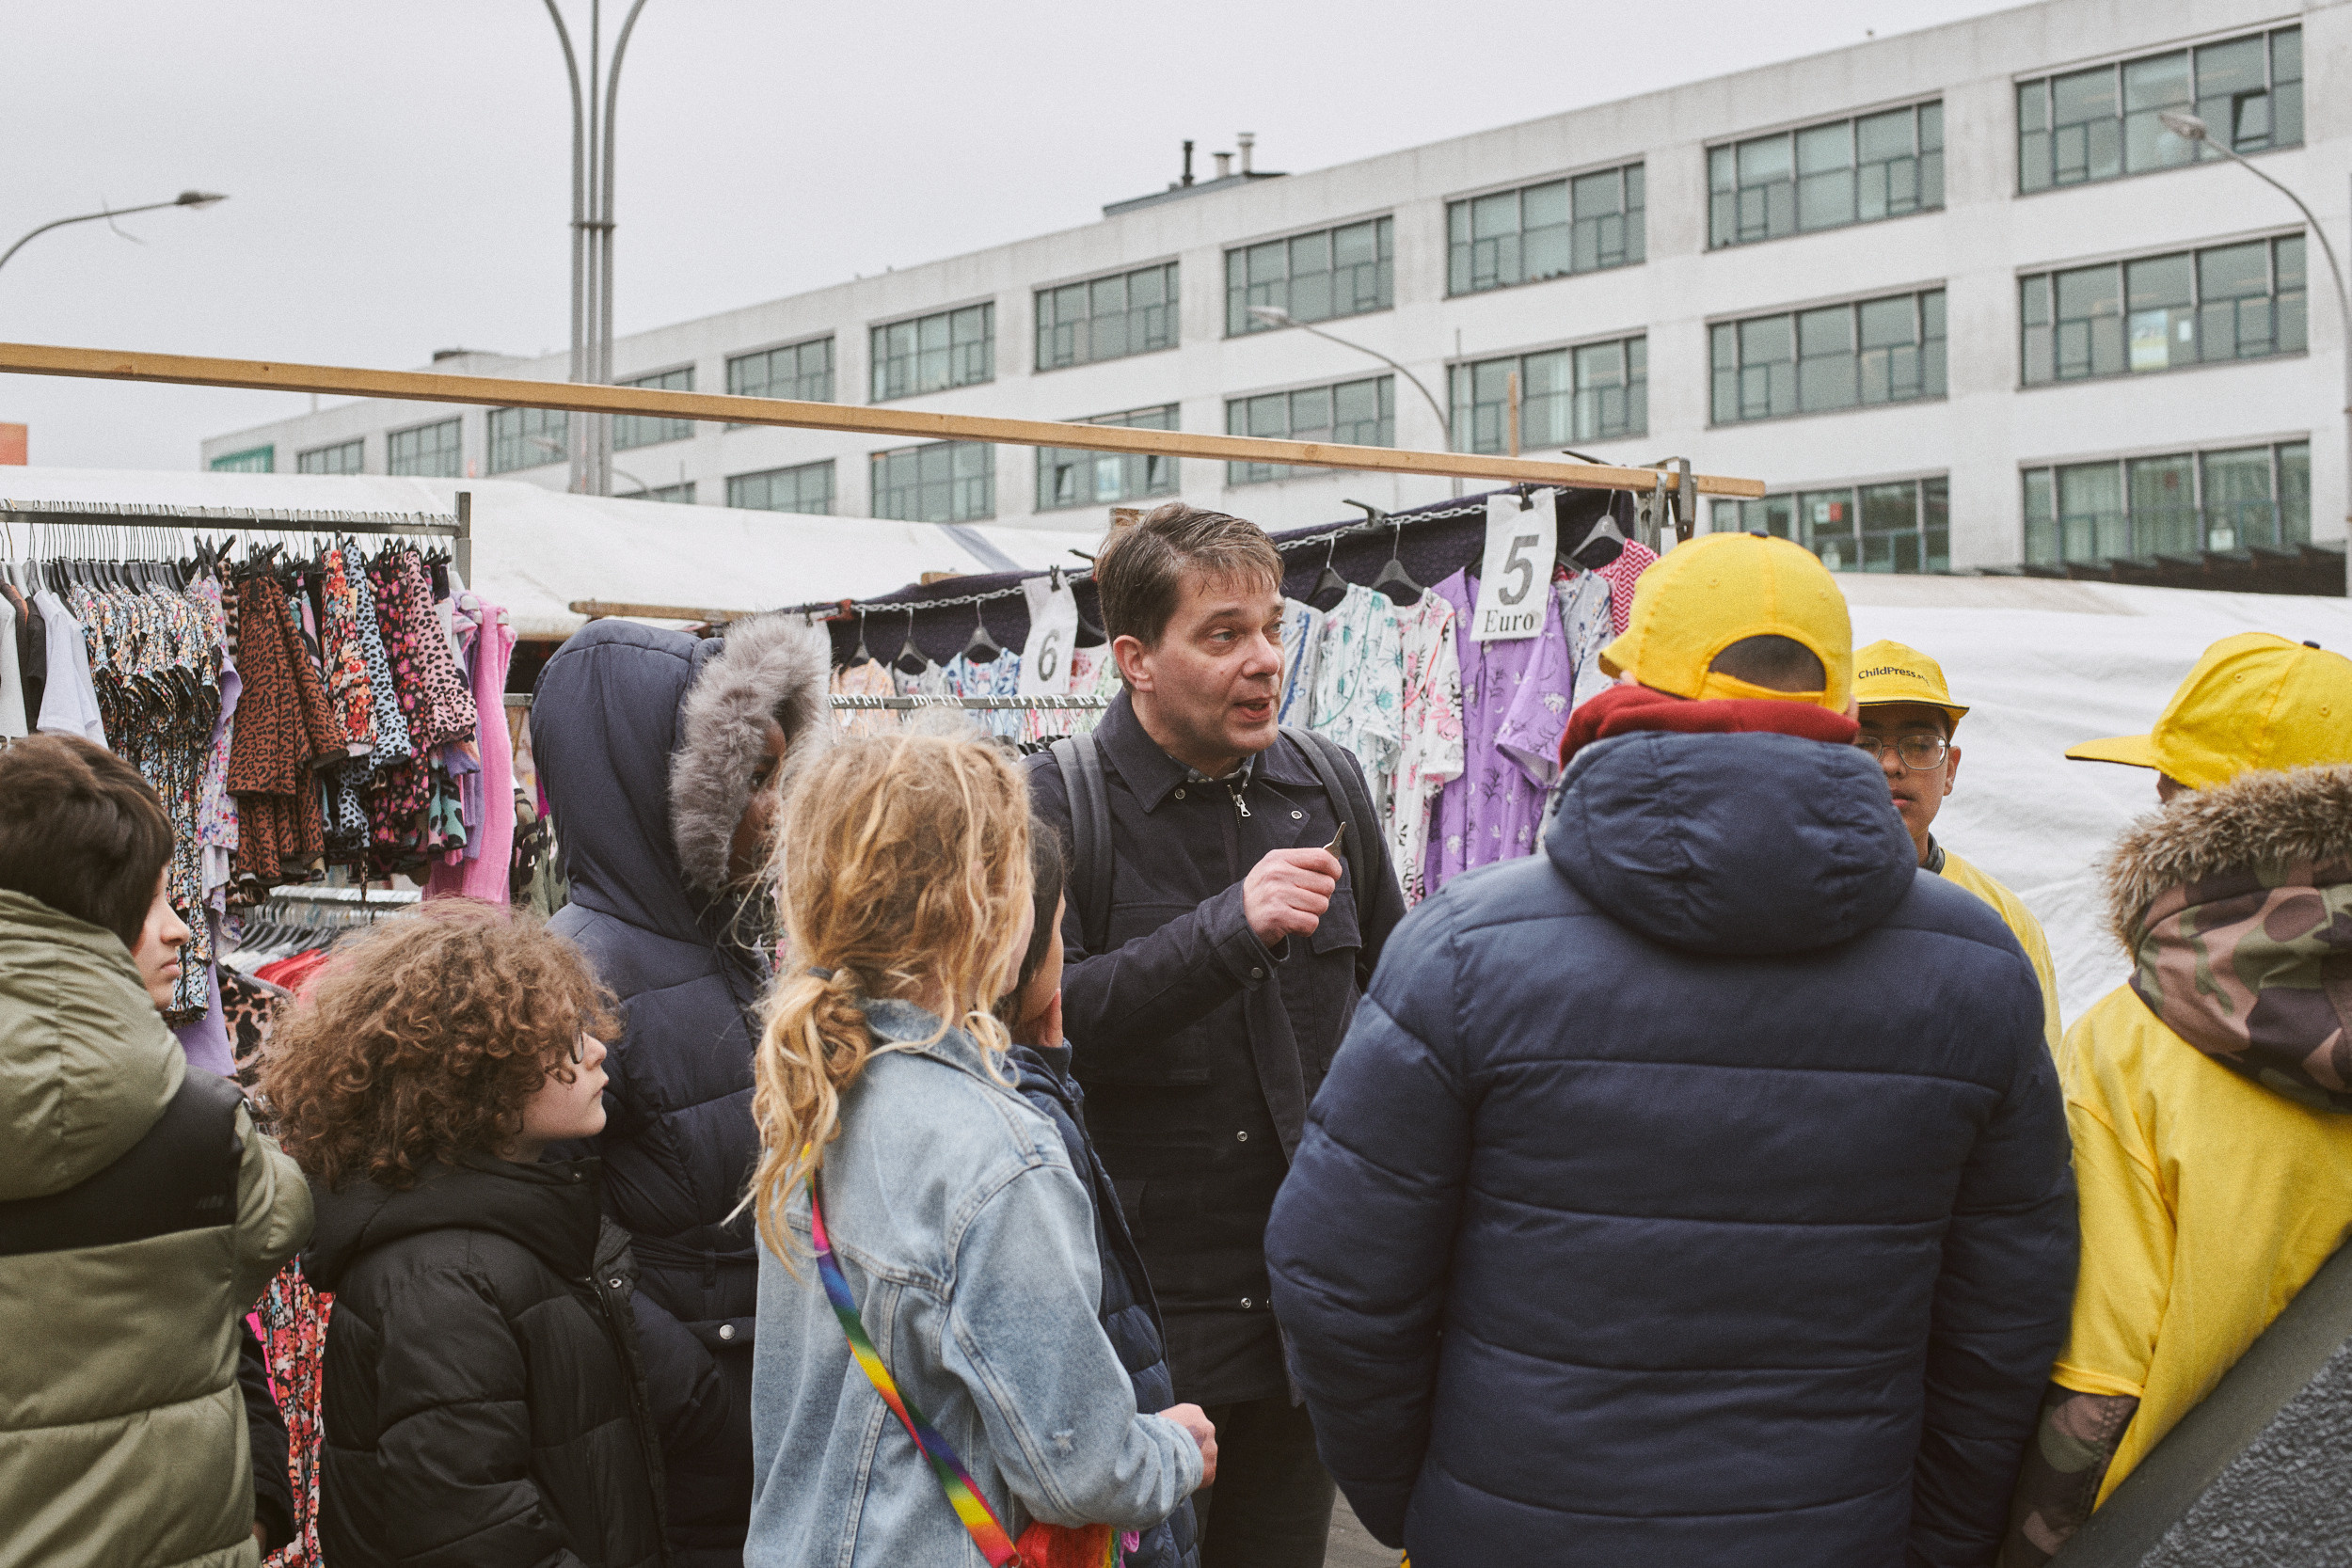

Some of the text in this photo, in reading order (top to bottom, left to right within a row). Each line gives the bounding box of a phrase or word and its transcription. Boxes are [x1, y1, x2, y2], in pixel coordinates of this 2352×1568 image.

[1499, 534, 1539, 606] 5
[1485, 610, 1534, 633] Euro
[1038, 628, 1059, 682] 6
[1858, 666, 1930, 687] ChildPress.
